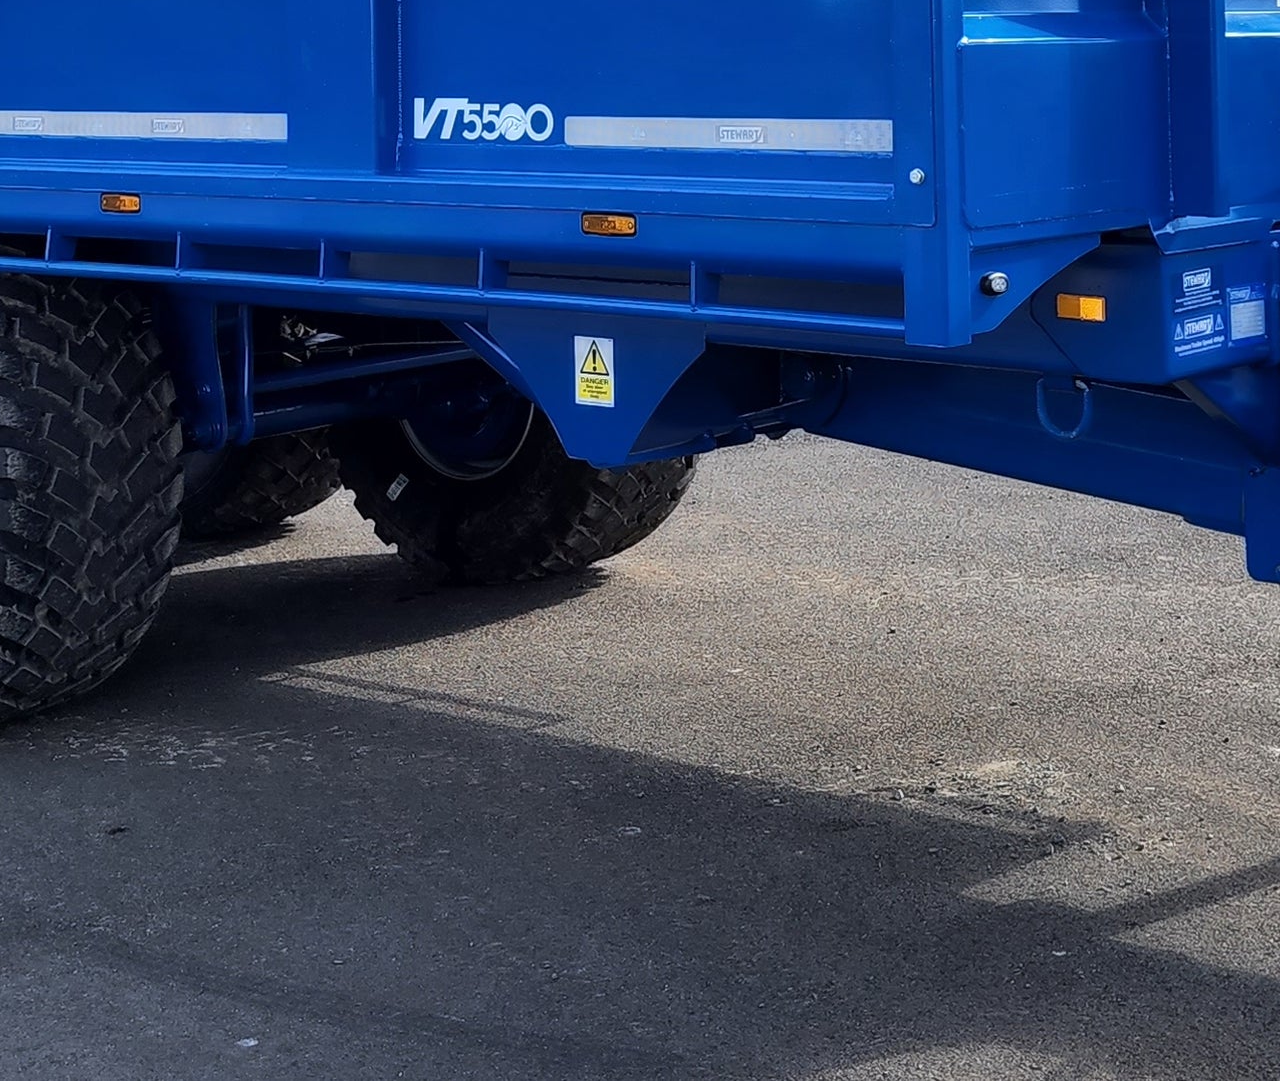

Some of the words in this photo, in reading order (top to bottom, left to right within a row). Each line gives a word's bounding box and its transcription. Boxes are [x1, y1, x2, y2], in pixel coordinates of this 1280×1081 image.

[413, 97, 554, 142] VT5500
[720, 128, 763, 143] STEWART
[580, 377, 609, 386] DANGER
